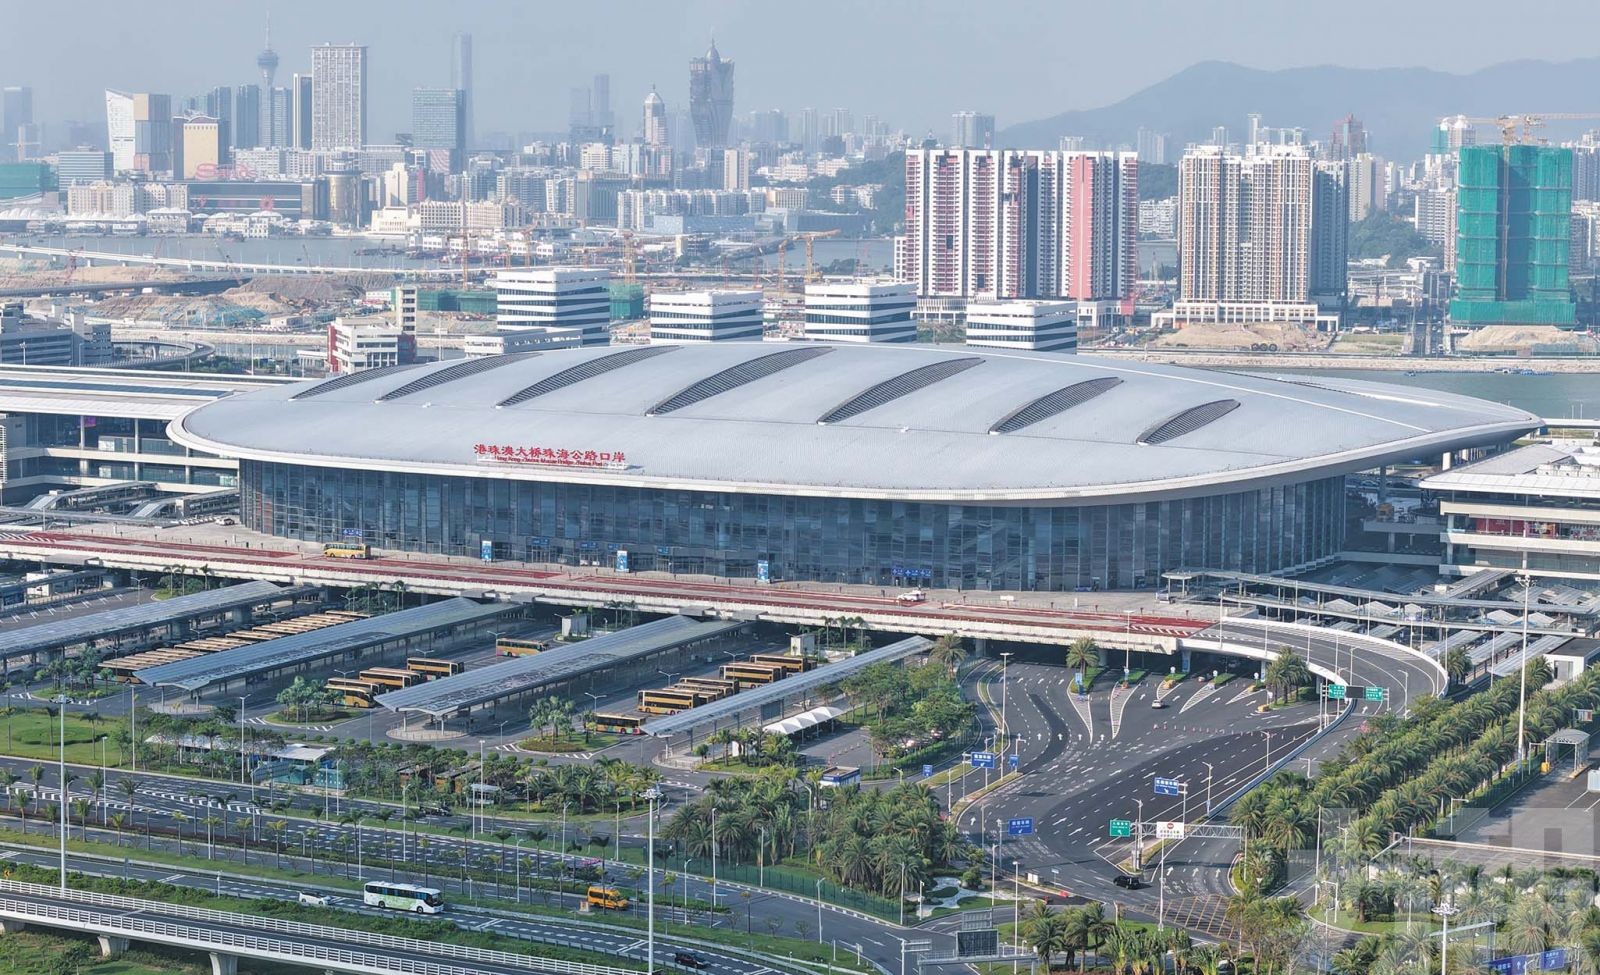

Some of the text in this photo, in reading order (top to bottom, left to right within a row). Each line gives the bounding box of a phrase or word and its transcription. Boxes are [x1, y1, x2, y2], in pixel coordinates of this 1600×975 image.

[474, 444, 625, 462] 港珠澳大桥珠海公路口岸
